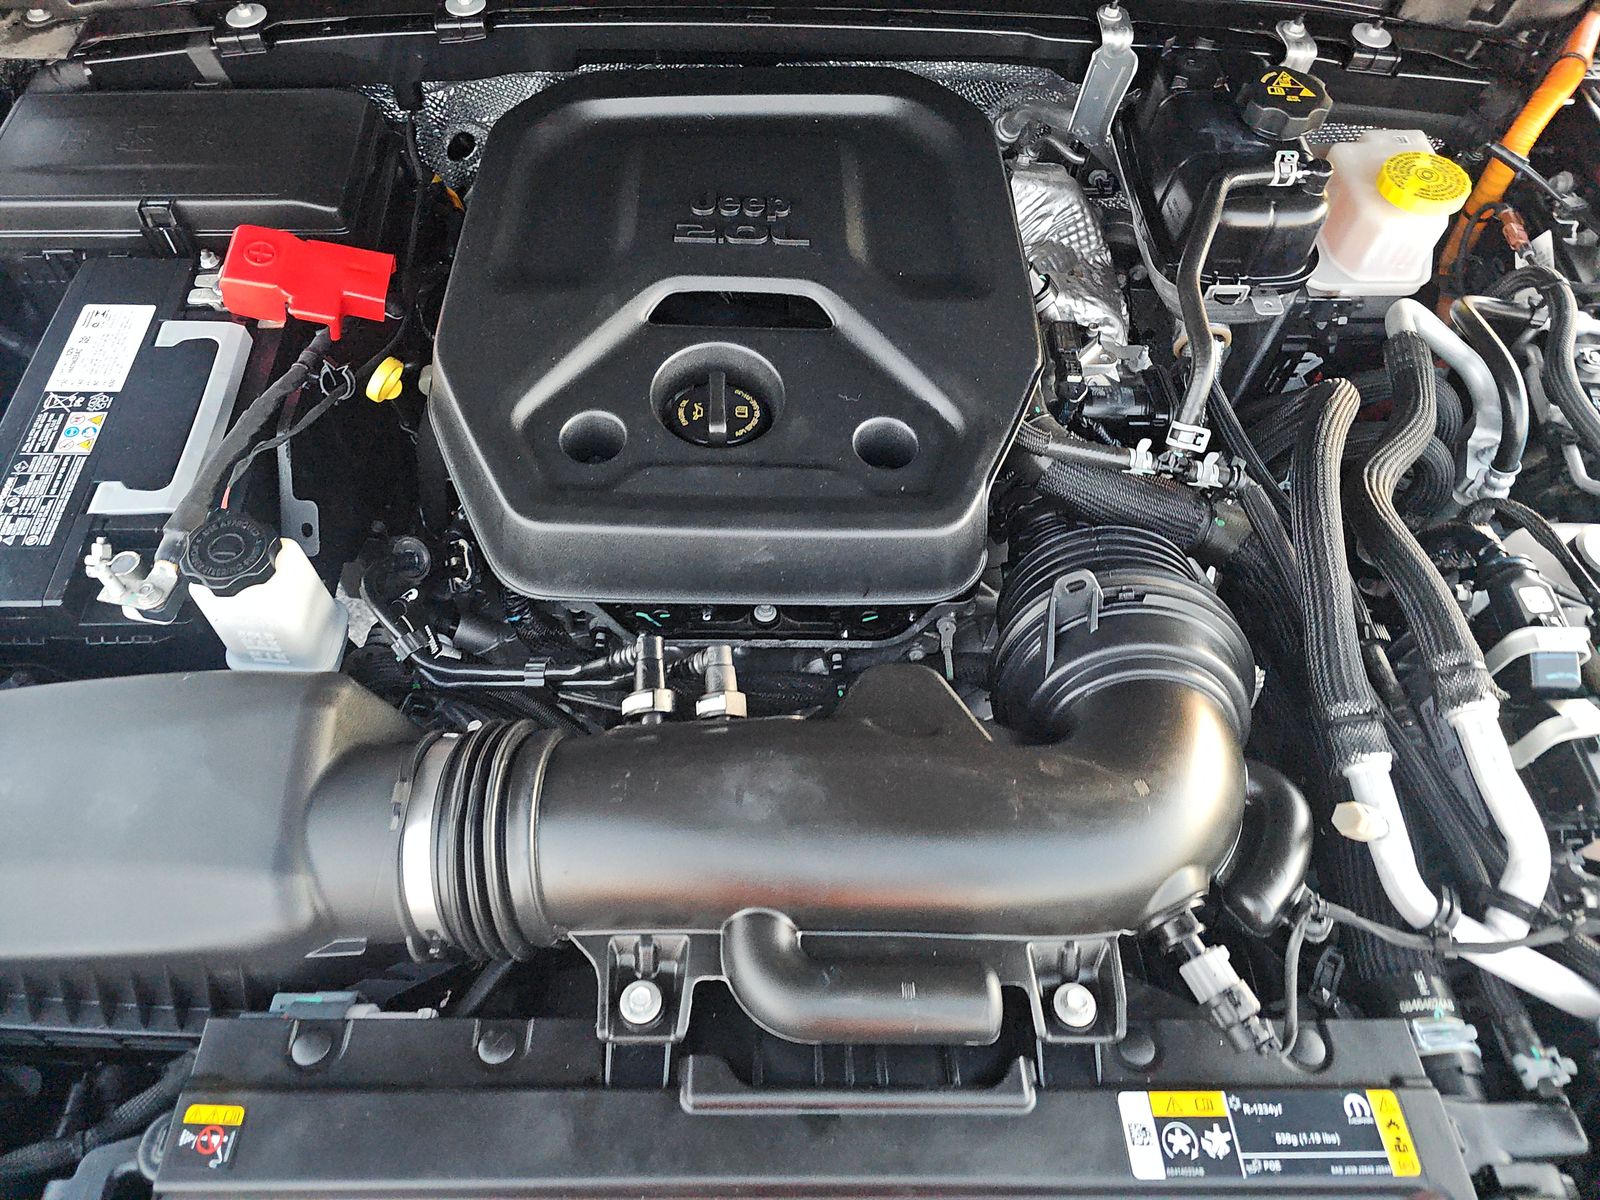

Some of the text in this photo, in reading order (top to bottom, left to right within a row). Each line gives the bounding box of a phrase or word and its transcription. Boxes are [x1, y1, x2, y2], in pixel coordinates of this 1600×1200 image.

[690, 191, 791, 222] Jeep
[674, 224, 810, 247] 2.0L
[1242, 1103, 1283, 1117] R-1234yf
